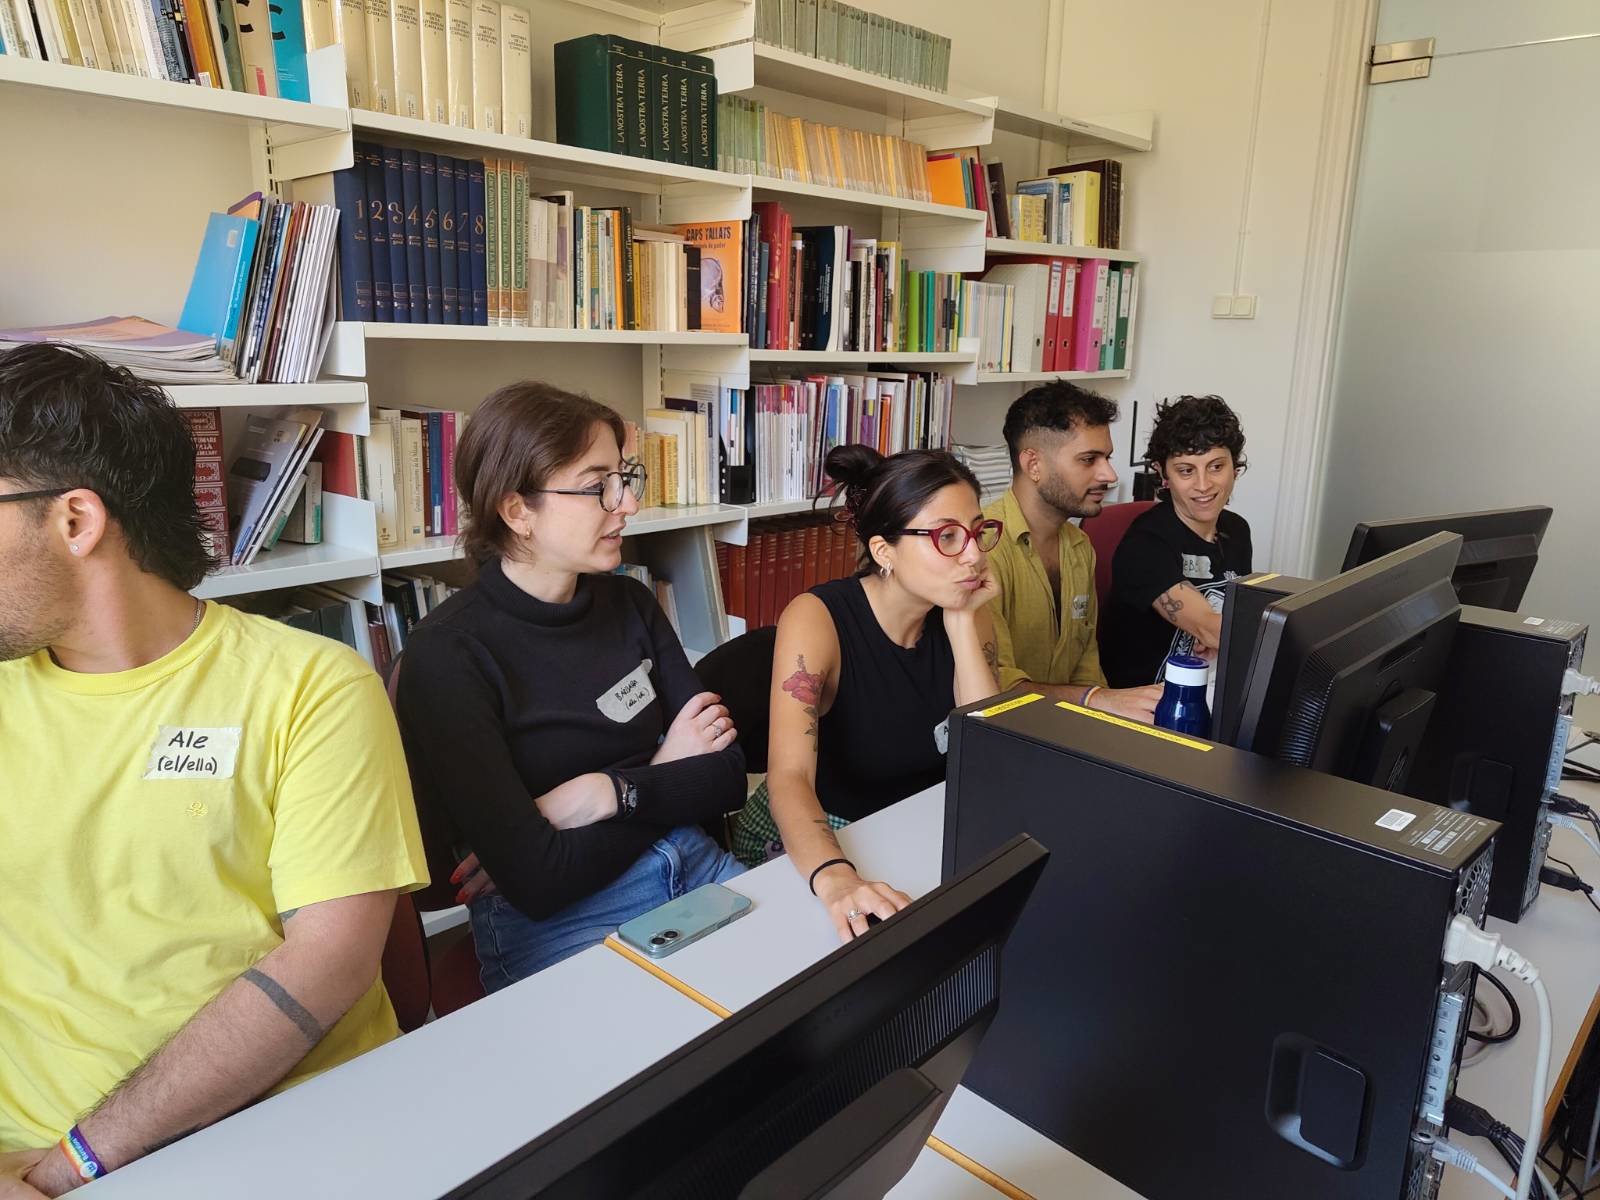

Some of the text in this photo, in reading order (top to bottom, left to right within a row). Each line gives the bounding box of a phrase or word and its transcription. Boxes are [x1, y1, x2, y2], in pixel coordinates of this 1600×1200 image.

[661, 74, 669, 104] TERRA
[680, 78, 688, 108] TERRA
[700, 82, 708, 112] TERRA
[615, 63, 625, 143] LA NOSTRA TERRA
[638, 102, 646, 135] NOSTRA
[639, 136, 647, 148] LA
[662, 140, 670, 150] LA
[682, 143, 688, 154] LA
[702, 146, 708, 157] LA
[355, 199, 364, 219] 1
[371, 200, 384, 221] 2
[388, 202, 403, 224] 3
[407, 204, 419, 225] 4
[424, 208, 438, 228] 5
[443, 211, 453, 231] 6
[457, 212, 468, 232] 7
[474, 215, 484, 235] 8
[687, 226, 731, 240] CAPS TALLATS
[168, 730, 208, 749] Ale
[158, 754, 218, 775] (el/ella)
